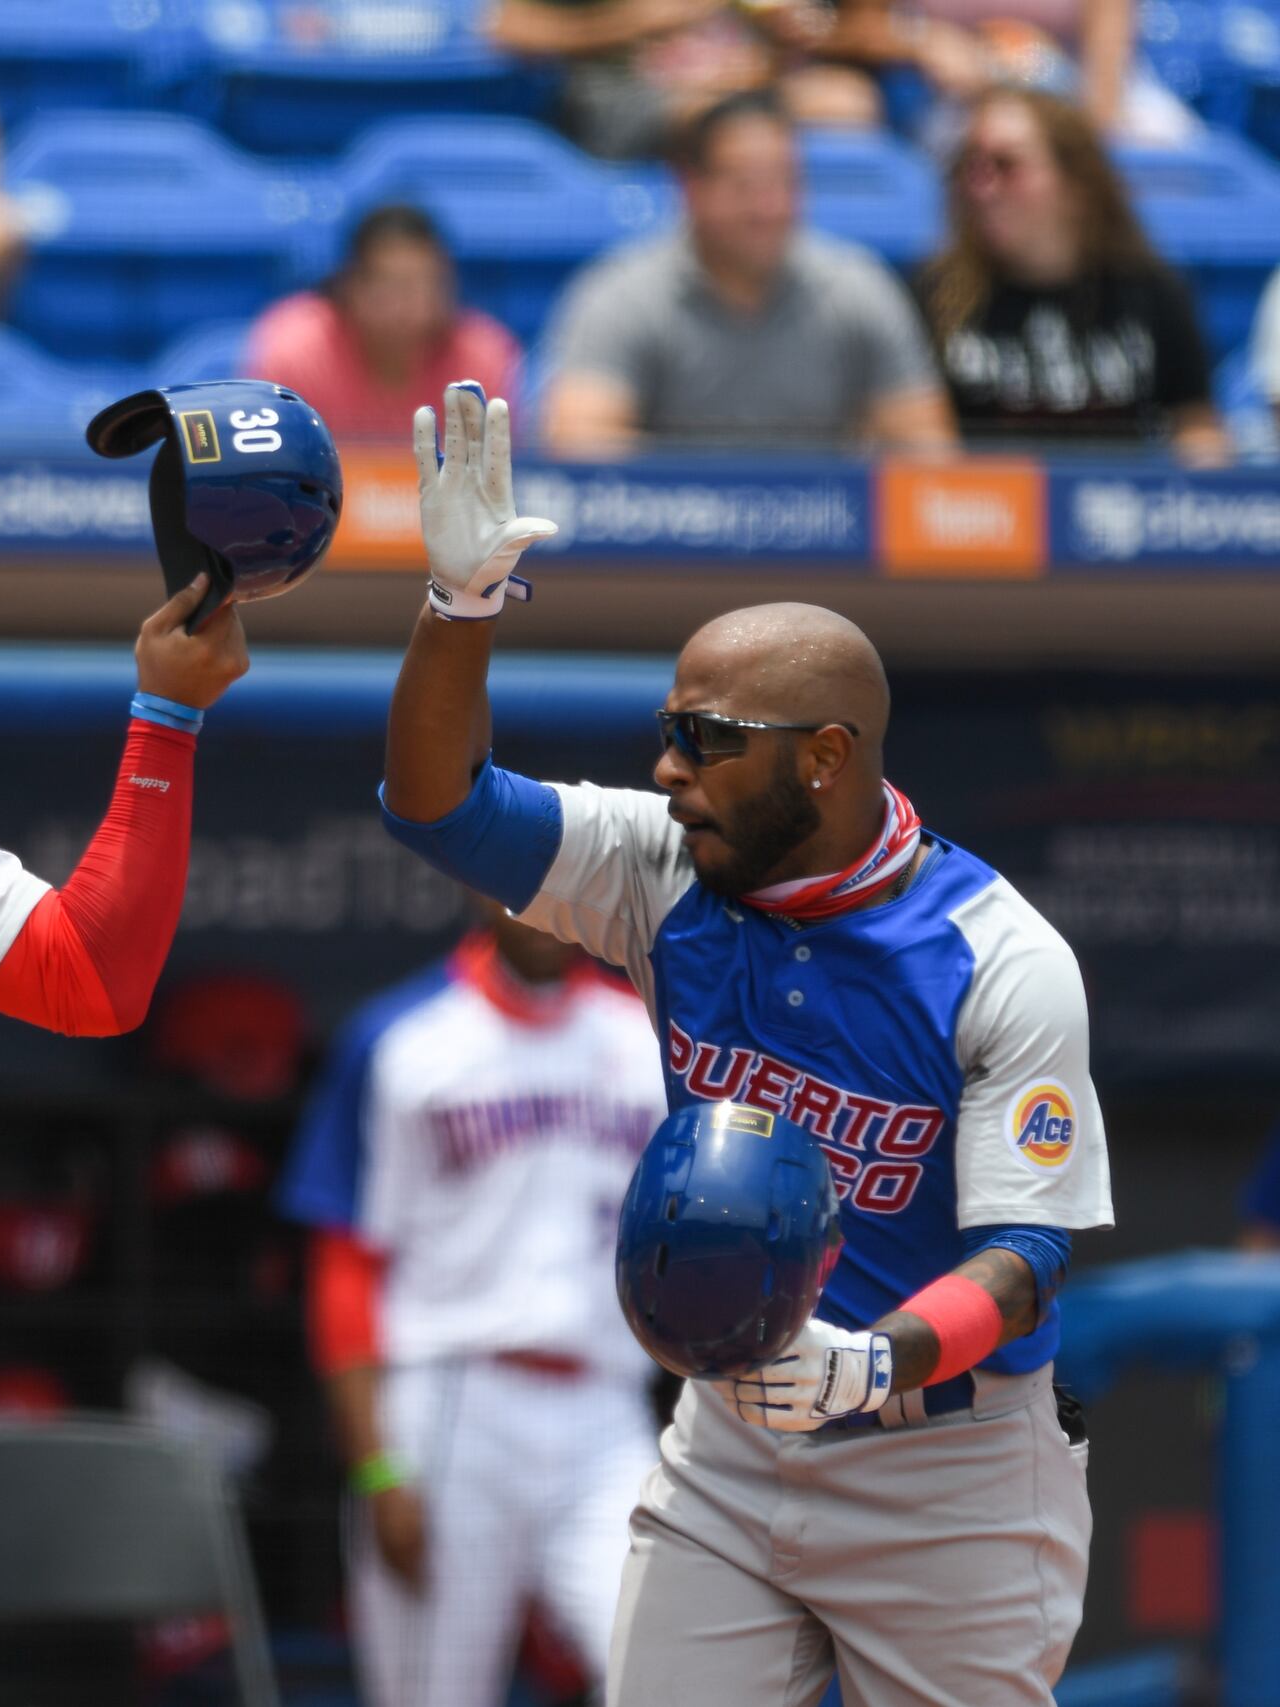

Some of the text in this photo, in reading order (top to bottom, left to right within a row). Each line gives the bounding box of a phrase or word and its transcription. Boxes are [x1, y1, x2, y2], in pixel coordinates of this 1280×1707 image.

[230, 407, 282, 453] 30
[670, 1018, 945, 1158] PUERTO
[1016, 1100, 1072, 1147] Ace
[819, 1143, 924, 1213] CO
[814, 1350, 838, 1416] Franklin
